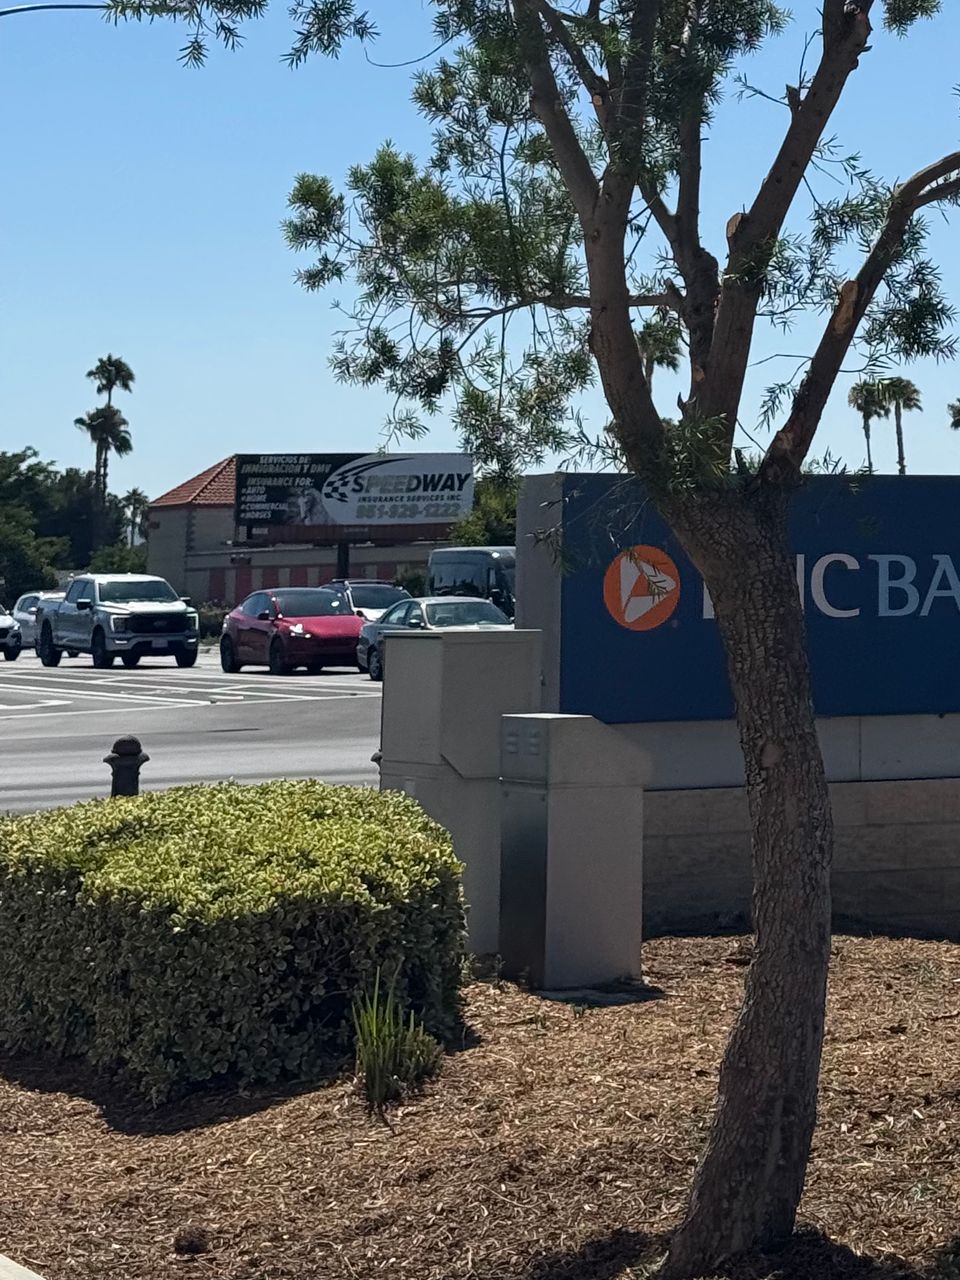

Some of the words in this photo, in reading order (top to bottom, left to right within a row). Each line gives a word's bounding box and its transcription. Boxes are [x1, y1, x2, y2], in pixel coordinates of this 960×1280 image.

[303, 464, 309, 473] Y
[310, 463, 332, 473] DMV
[246, 477, 294, 486] INSURANCE
[351, 473, 472, 494] SPEEDWAY
[358, 495, 403, 503] INSURANCE
